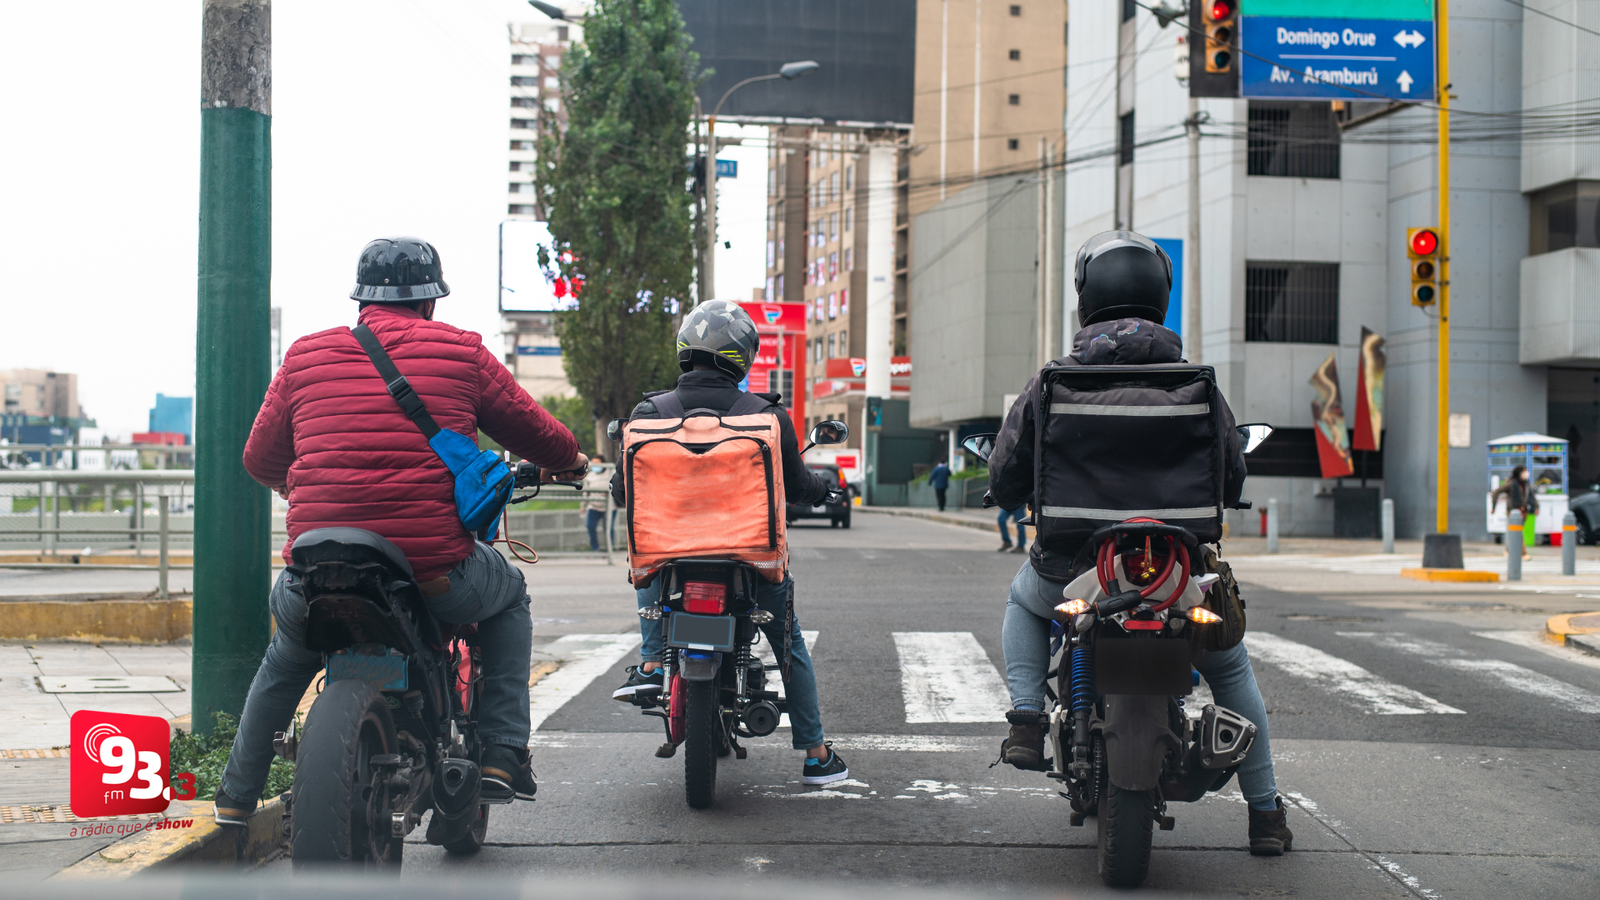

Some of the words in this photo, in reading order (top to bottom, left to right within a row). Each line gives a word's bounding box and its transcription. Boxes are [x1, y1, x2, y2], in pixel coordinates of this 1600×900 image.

[1277, 27, 1340, 49] Domingo
[1342, 28, 1376, 47] Orue
[1270, 65, 1294, 83] Av.
[1303, 66, 1378, 85] Aramburú
